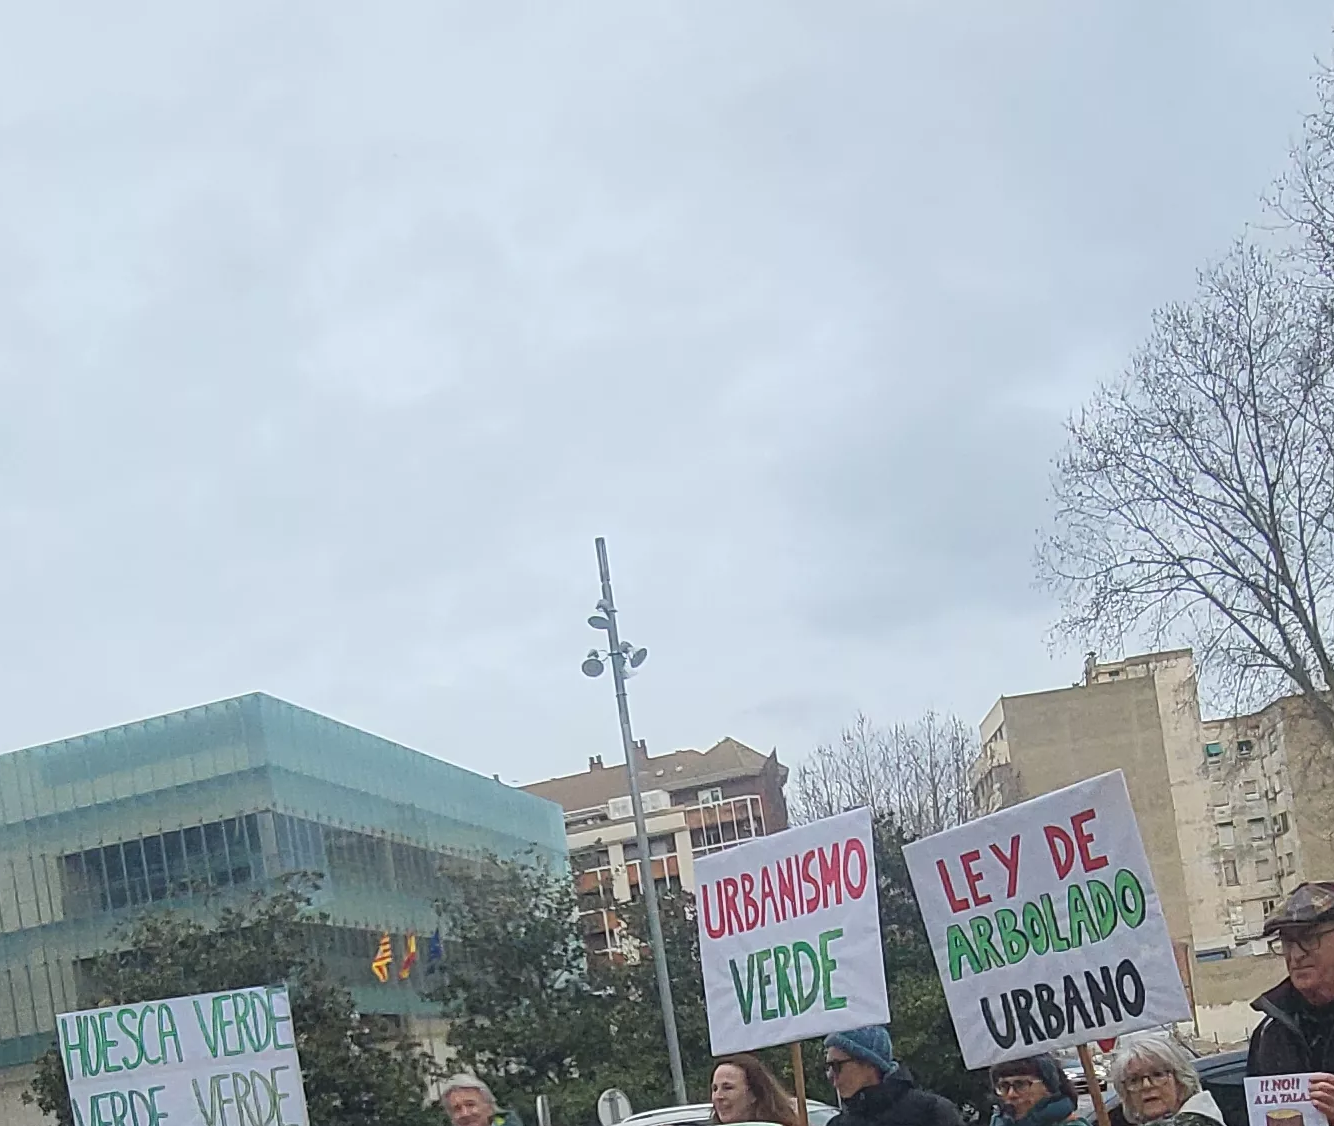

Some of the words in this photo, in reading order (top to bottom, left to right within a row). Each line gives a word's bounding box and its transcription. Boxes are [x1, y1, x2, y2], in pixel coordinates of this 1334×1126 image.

[701, 838, 868, 939] URBANISMO
[936, 834, 1021, 913] LEY
[1044, 808, 1109, 880] DE
[947, 868, 1146, 981] ARBOLADO
[729, 928, 847, 1025] VERDE
[980, 959, 1146, 1049] URBANO
[60, 1003, 183, 1080] HUESCA
[193, 984, 294, 1059] VERDE
[1255, 1095, 1263, 1105] A
[1265, 1094, 1279, 1105] LA
